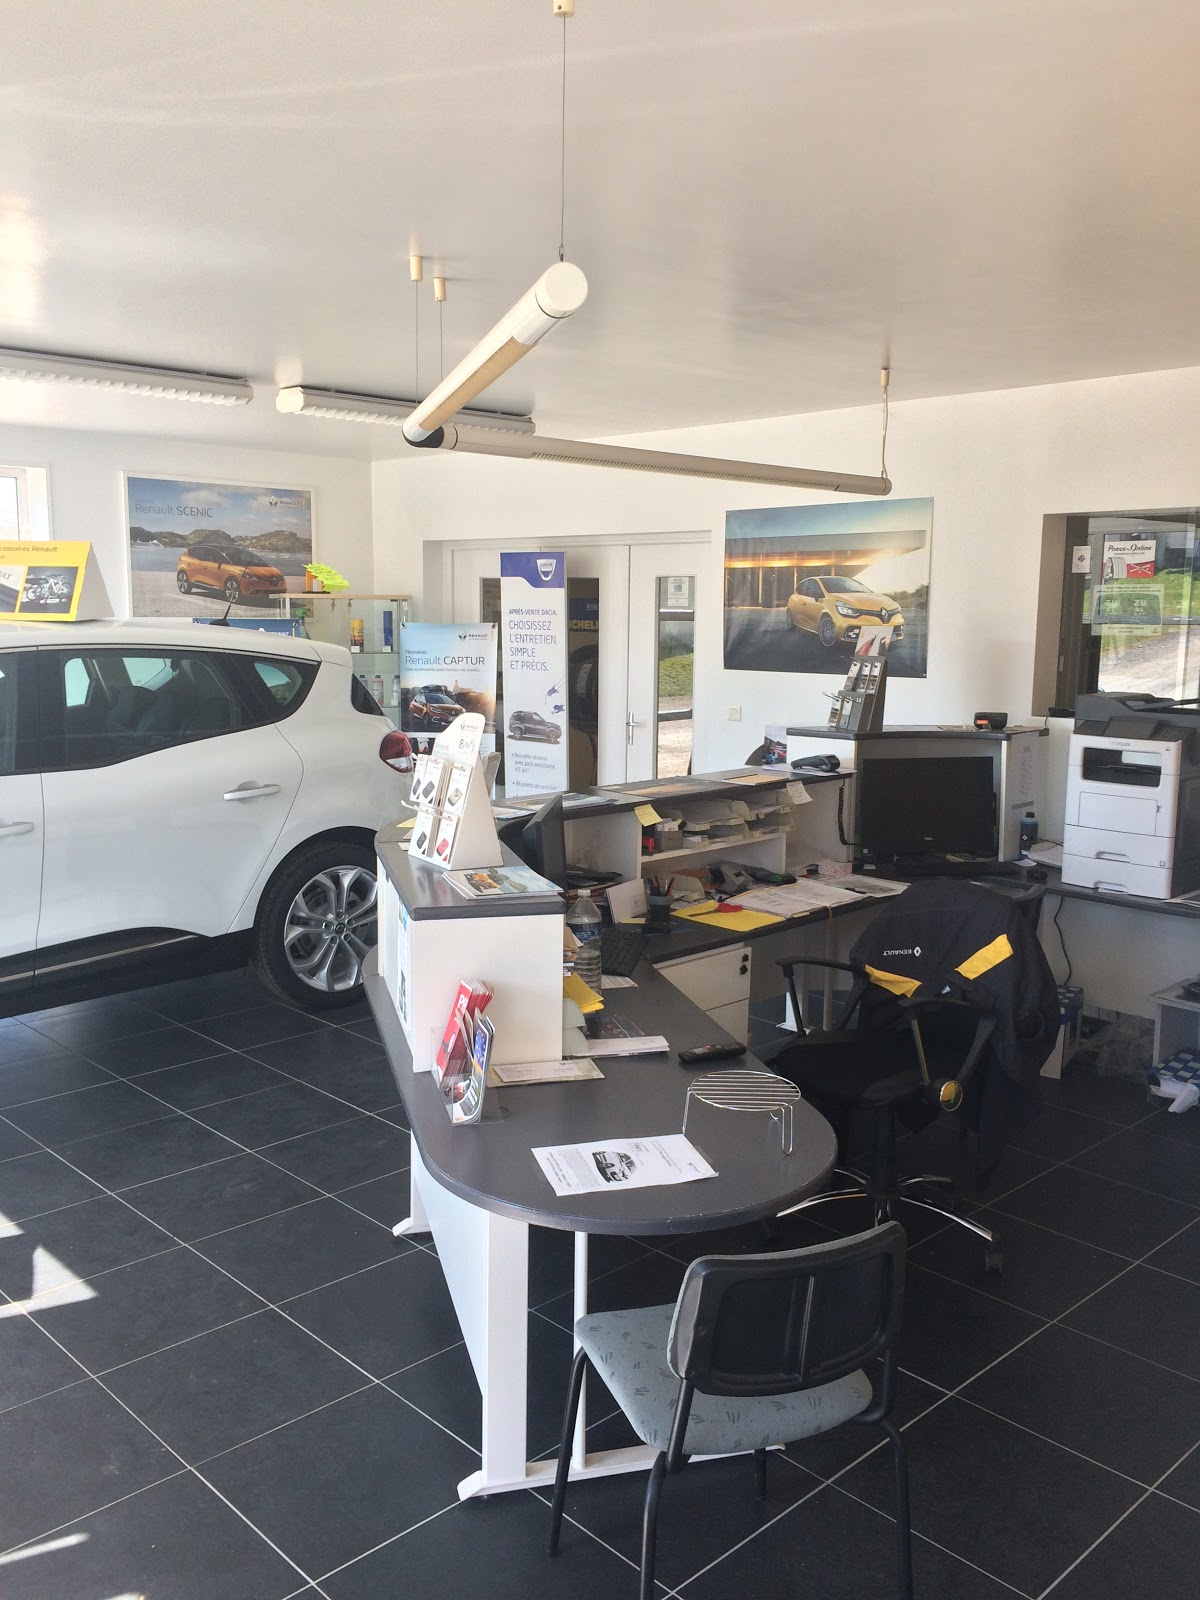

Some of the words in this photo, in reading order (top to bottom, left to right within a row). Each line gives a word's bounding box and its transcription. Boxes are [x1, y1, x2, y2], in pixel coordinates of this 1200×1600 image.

[135, 503, 174, 515] Renault
[176, 505, 214, 518] SCENIC
[508, 620, 552, 631] CHOISISSEZ
[509, 634, 557, 644] L'ENTRETIEN
[510, 647, 536, 657] SIMPLE
[405, 655, 442, 665] Renault
[443, 656, 485, 665] CAPTUR
[510, 660, 520, 670] ET
[521, 659, 549, 672] PRÉCIS.
